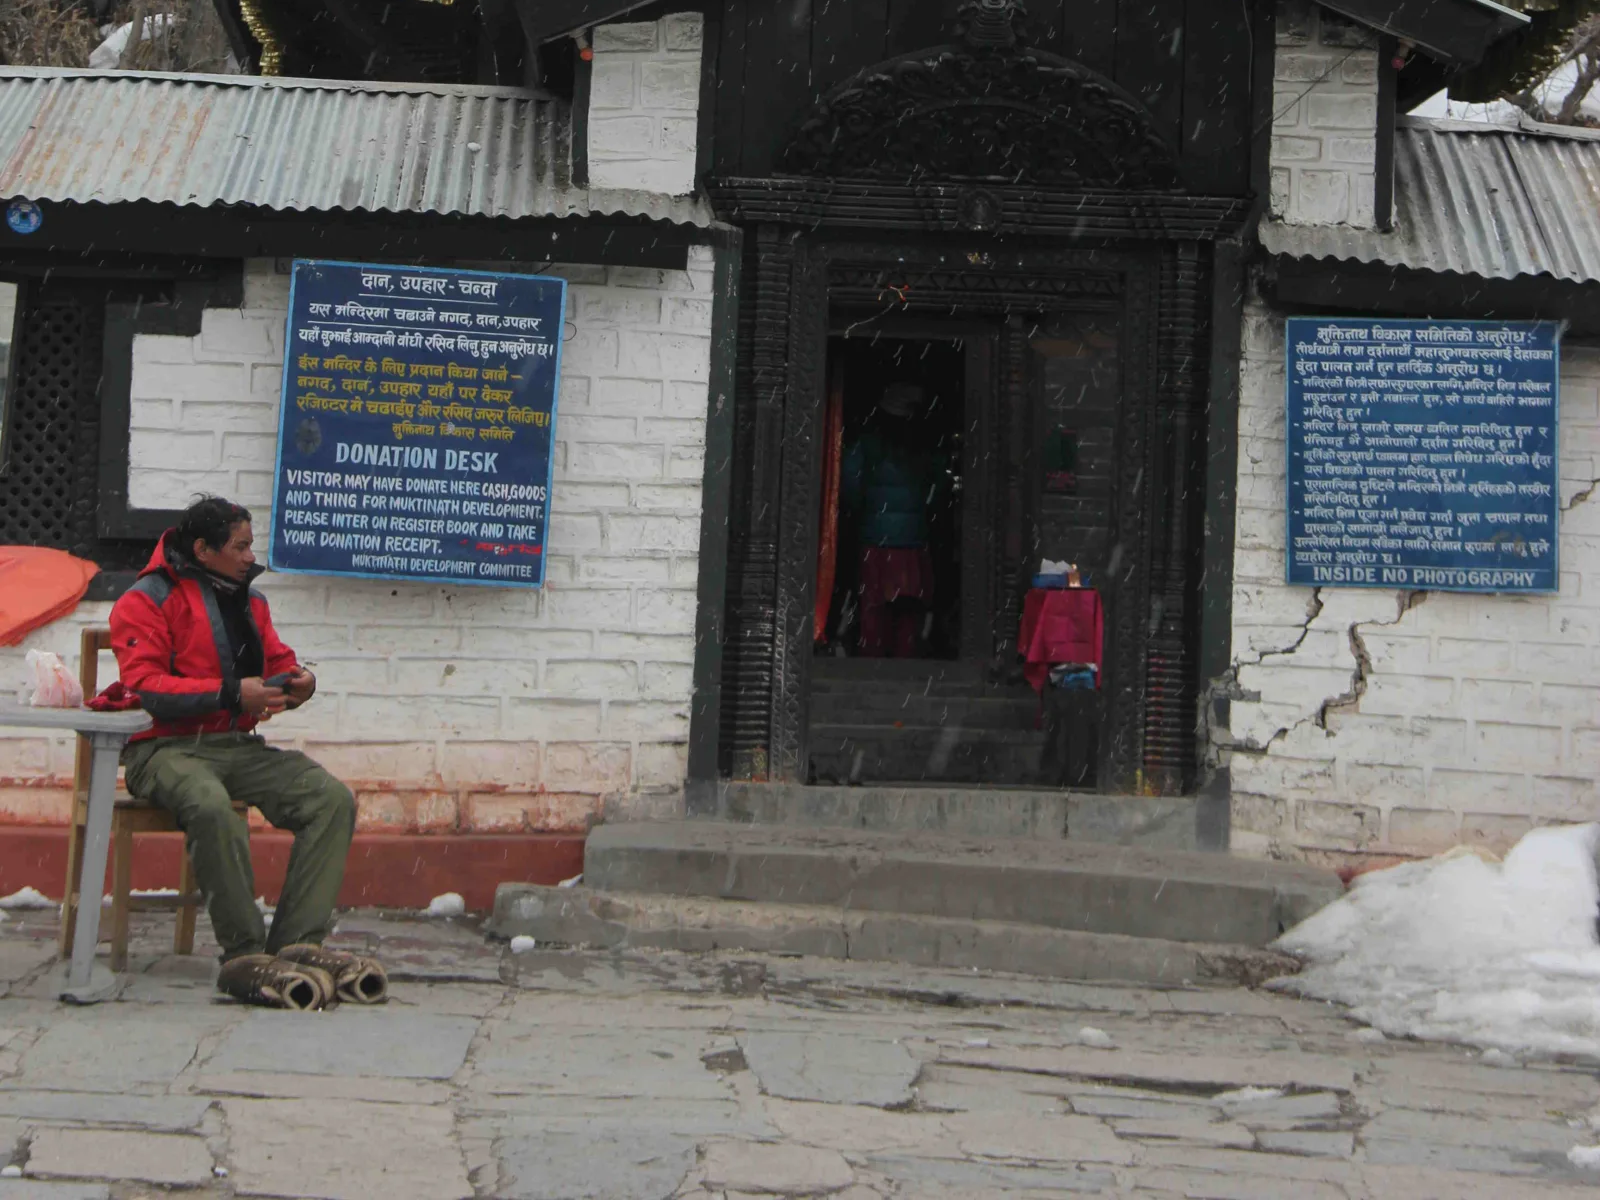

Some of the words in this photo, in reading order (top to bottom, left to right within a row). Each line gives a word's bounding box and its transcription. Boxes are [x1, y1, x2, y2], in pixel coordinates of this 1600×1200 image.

[458, 280, 498, 298] चन्दा
[309, 302, 332, 318] यस
[336, 442, 437, 469] DONATION
[444, 449, 498, 473] DESK
[287, 469, 342, 488] VISITOR
[344, 474, 372, 491] MAY
[372, 476, 403, 492] HAVE
[405, 478, 448, 494] DONATE
[450, 480, 481, 496] HERE
[285, 490, 311, 506] AND
[313, 491, 357, 508] THING
[362, 494, 387, 510] FOR
[389, 496, 460, 515] MUKTINATH
[462, 501, 542, 519] DEVELOPMENT.
[284, 509, 329, 526] PLEASE
[331, 513, 369, 529] INTER
[371, 515, 388, 531] ON
[389, 516, 445, 534] REGISTER
[446, 519, 479, 536] BOOK
[480, 522, 504, 538] AND
[506, 524, 536, 541] TAKE
[283, 529, 316, 546] YOUR
[320, 531, 381, 551] DONATION
[384, 536, 442, 554] RECEIPT.
[352, 554, 408, 571] MUKTINATH
[410, 558, 476, 575] DEVELOPMENT
[479, 562, 532, 577] COMMITTEE
[1313, 566, 1376, 583] INSIDE
[1383, 568, 1408, 583] NO
[1413, 568, 1535, 586] PHOTOGRAPHY
